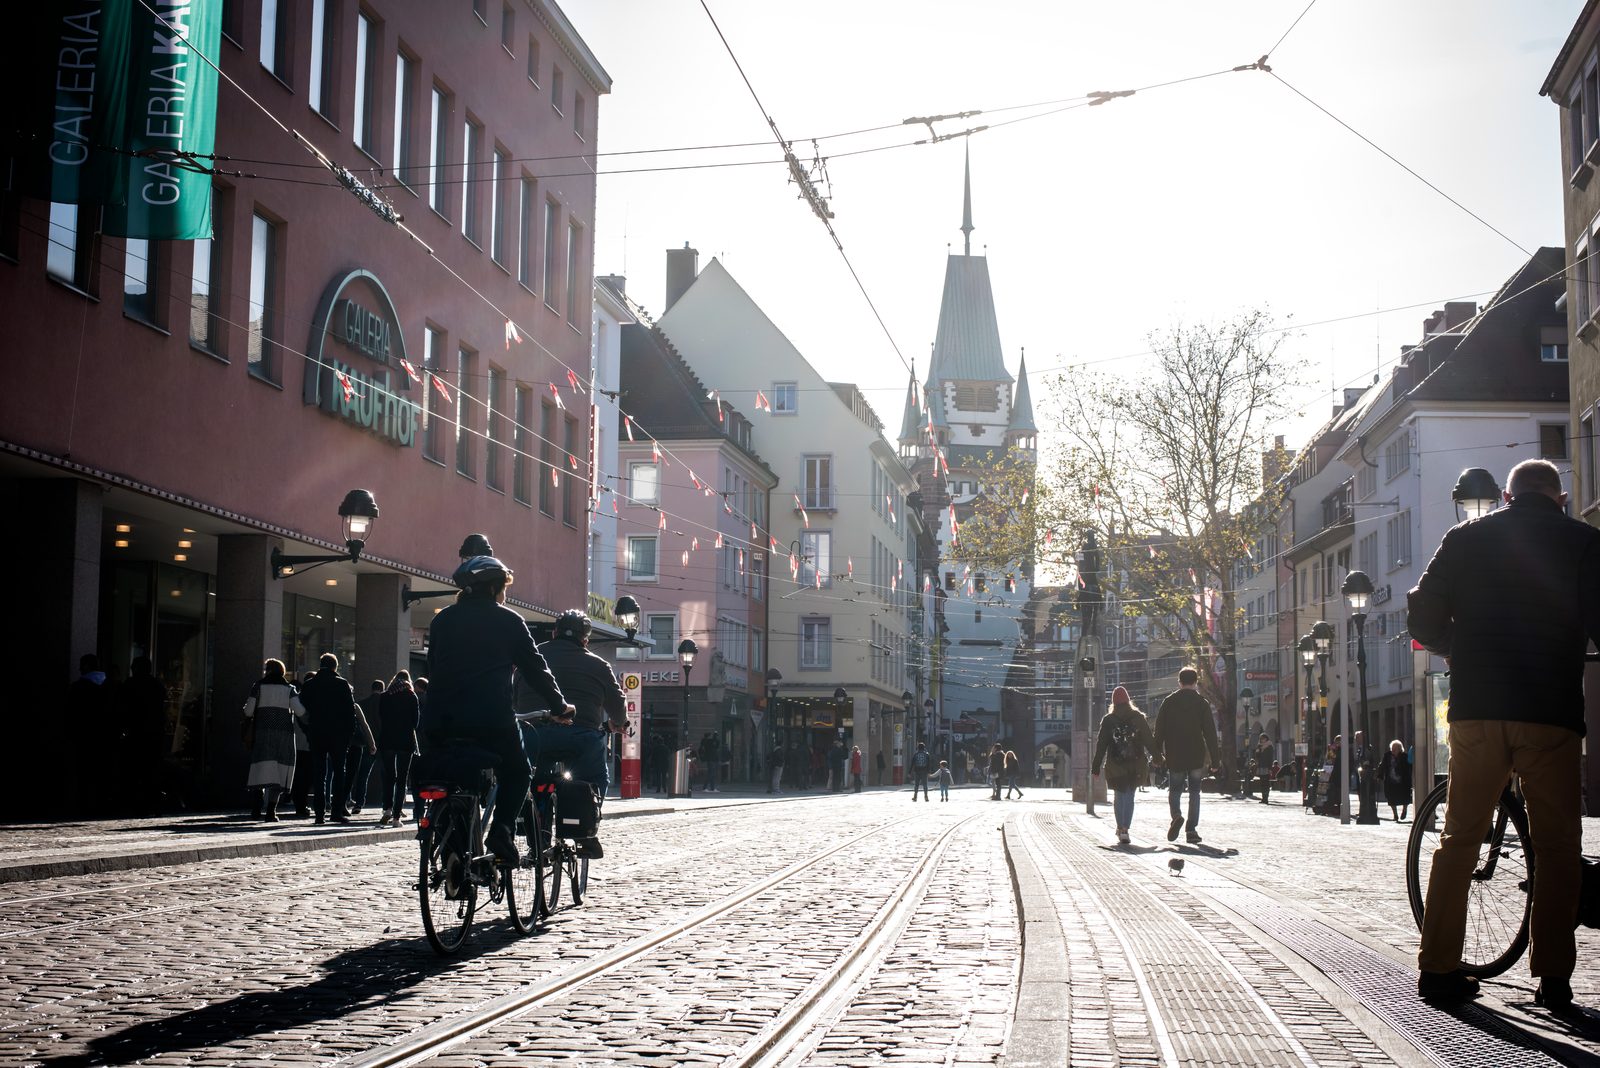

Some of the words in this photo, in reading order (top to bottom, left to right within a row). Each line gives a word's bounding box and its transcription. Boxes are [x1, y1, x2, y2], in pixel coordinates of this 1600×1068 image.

[49, 8, 101, 166] GALERIA
[141, 62, 188, 206] GALERIA
[345, 299, 391, 361] GALERIA
